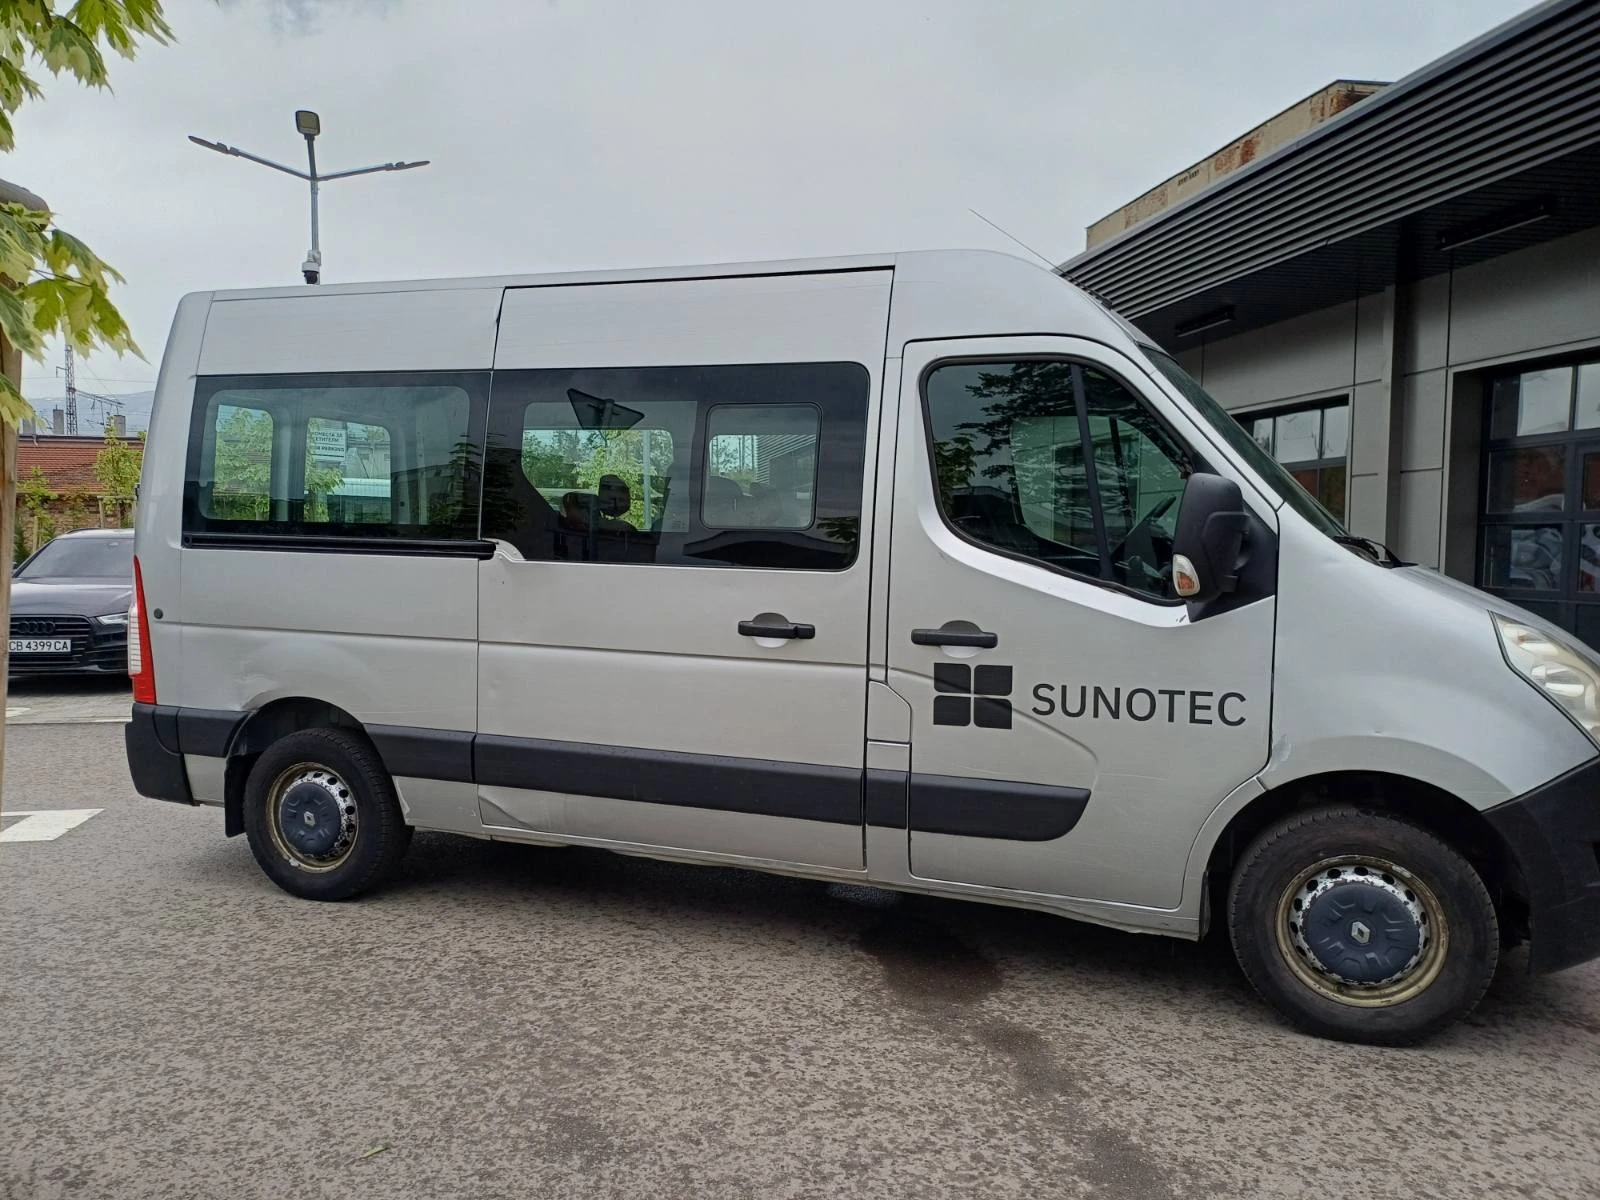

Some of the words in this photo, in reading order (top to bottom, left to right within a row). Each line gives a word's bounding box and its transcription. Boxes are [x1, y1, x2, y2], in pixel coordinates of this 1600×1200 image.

[9, 641, 23, 651] CB
[25, 641, 52, 651] 4399
[54, 641, 69, 651] CA
[1031, 683, 1247, 727] SUNOTEC
